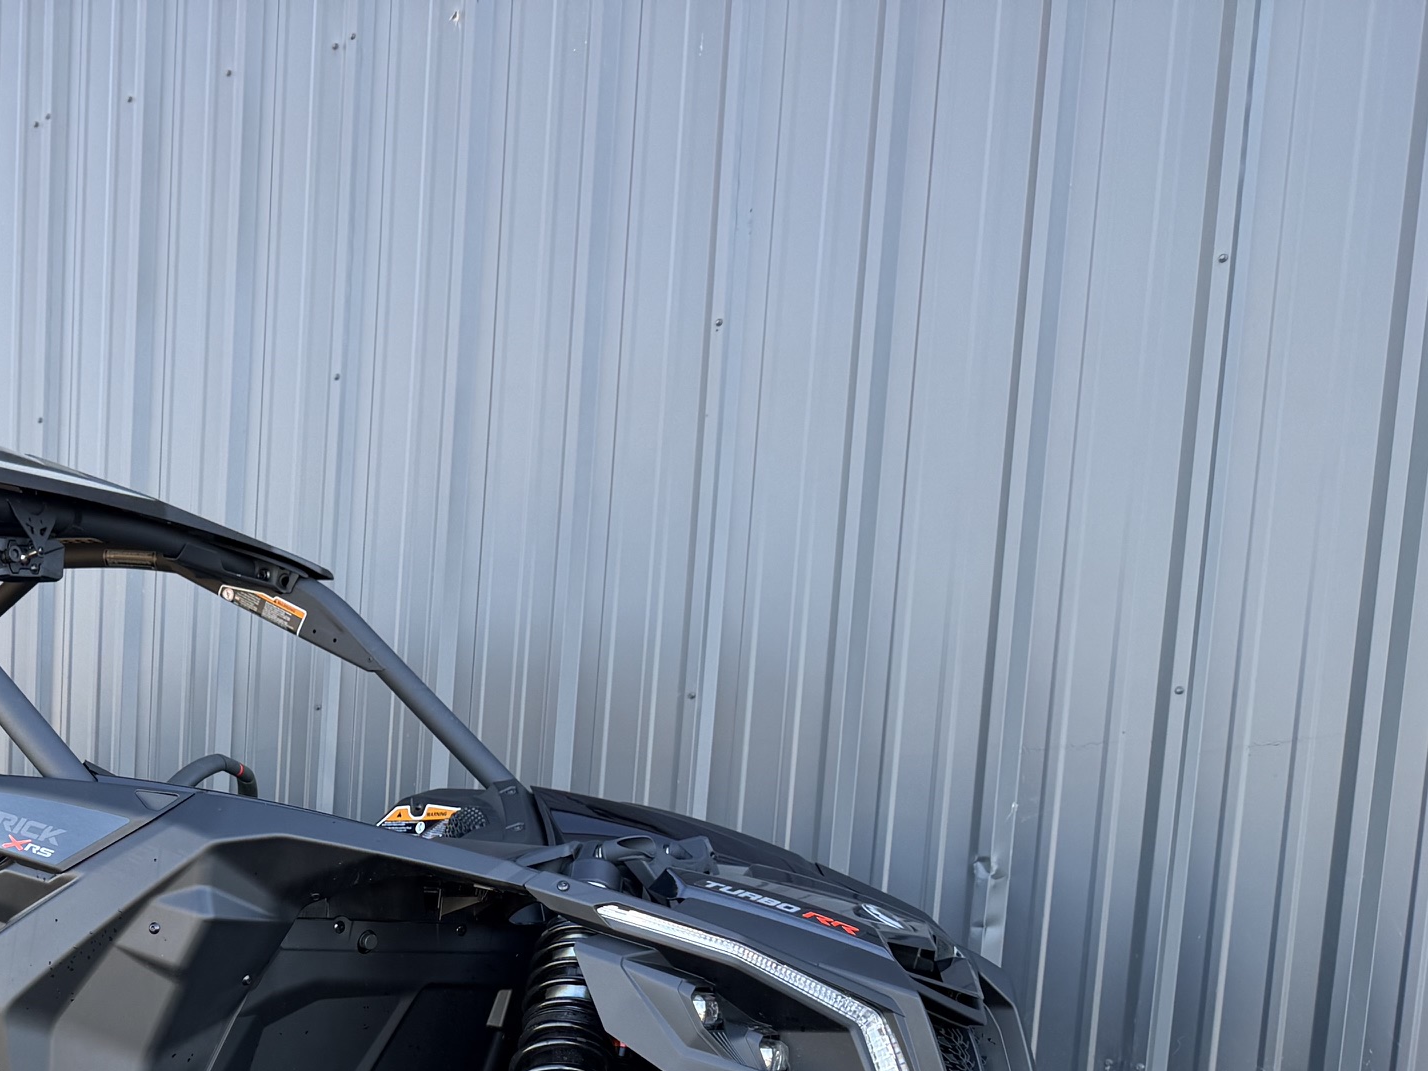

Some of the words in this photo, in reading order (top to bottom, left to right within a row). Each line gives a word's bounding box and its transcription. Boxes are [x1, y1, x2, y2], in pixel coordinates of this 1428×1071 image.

[1, 833, 55, 858] XRS
[704, 880, 801, 913] TURBO
[801, 911, 860, 936] RR
